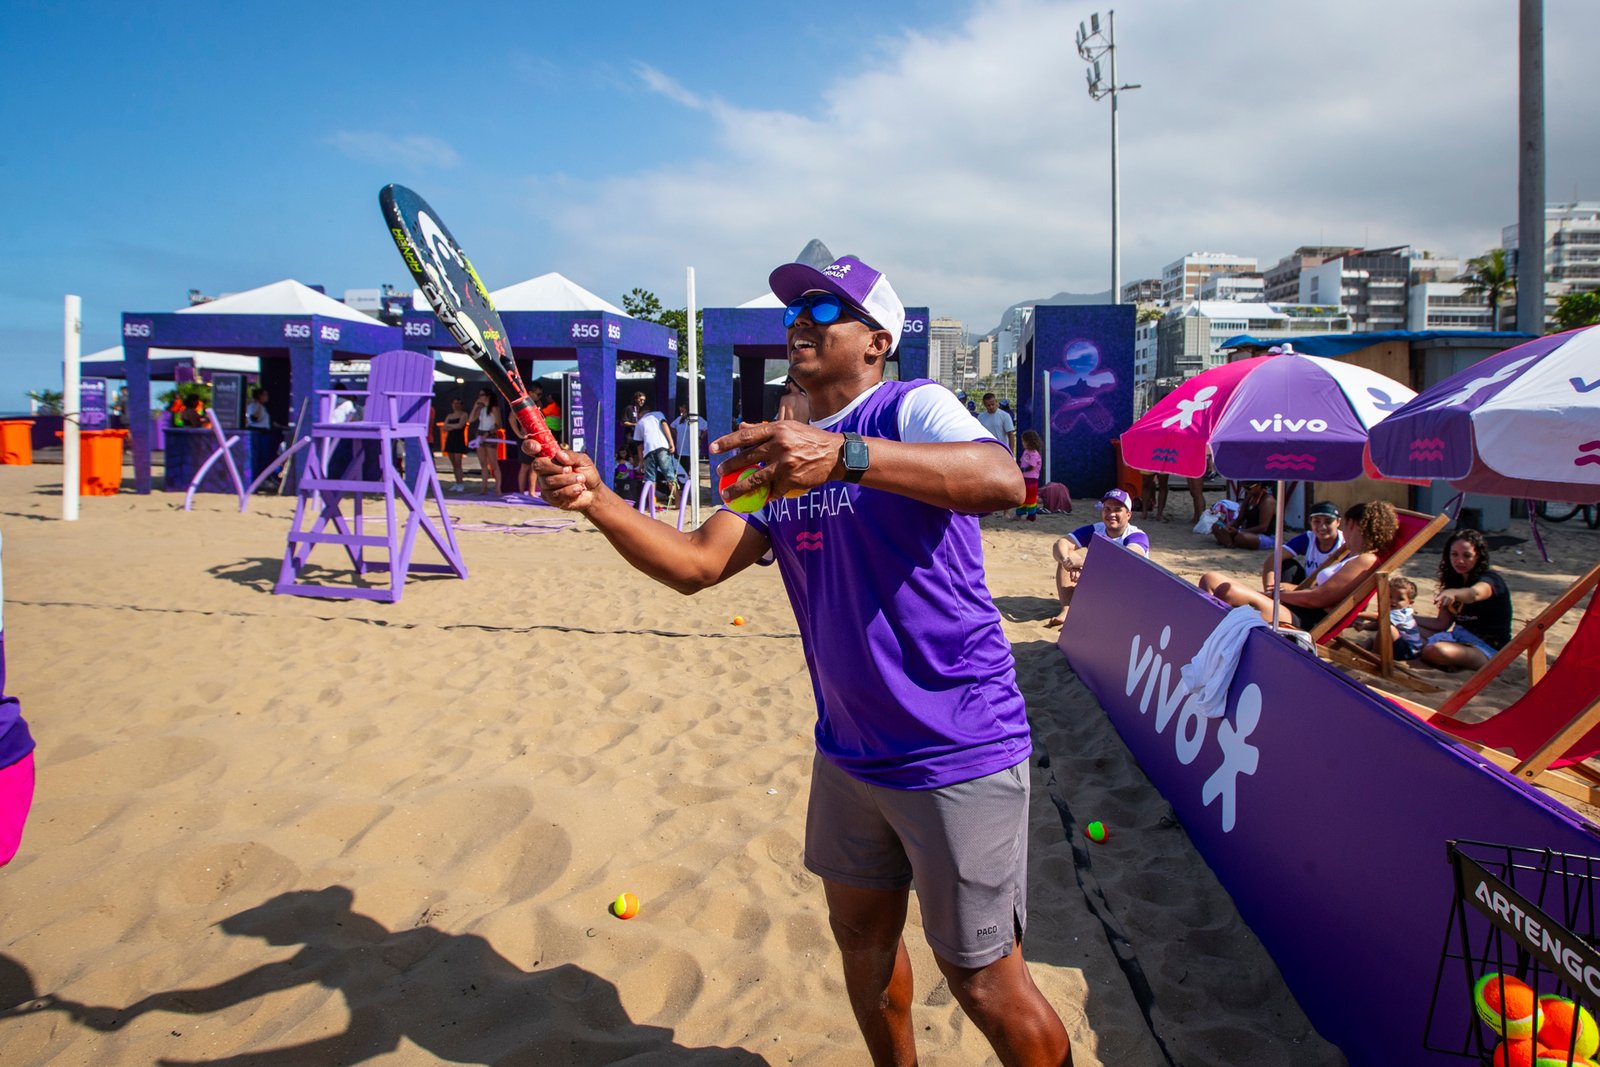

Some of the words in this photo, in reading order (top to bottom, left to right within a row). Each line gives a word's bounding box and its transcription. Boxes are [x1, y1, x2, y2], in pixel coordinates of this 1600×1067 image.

[422, 282, 486, 360] HEAD
[903, 319, 924, 333] 5G
[130, 324, 151, 338] 5G
[292, 324, 311, 338] 5G
[326, 326, 341, 342] 5G
[413, 322, 432, 337] 5G
[581, 323, 600, 338] 5G
[1249, 413, 1329, 432] vivo
[767, 496, 792, 522] NA
[1125, 625, 1208, 765] vivo
[976, 925, 998, 937] PACO
